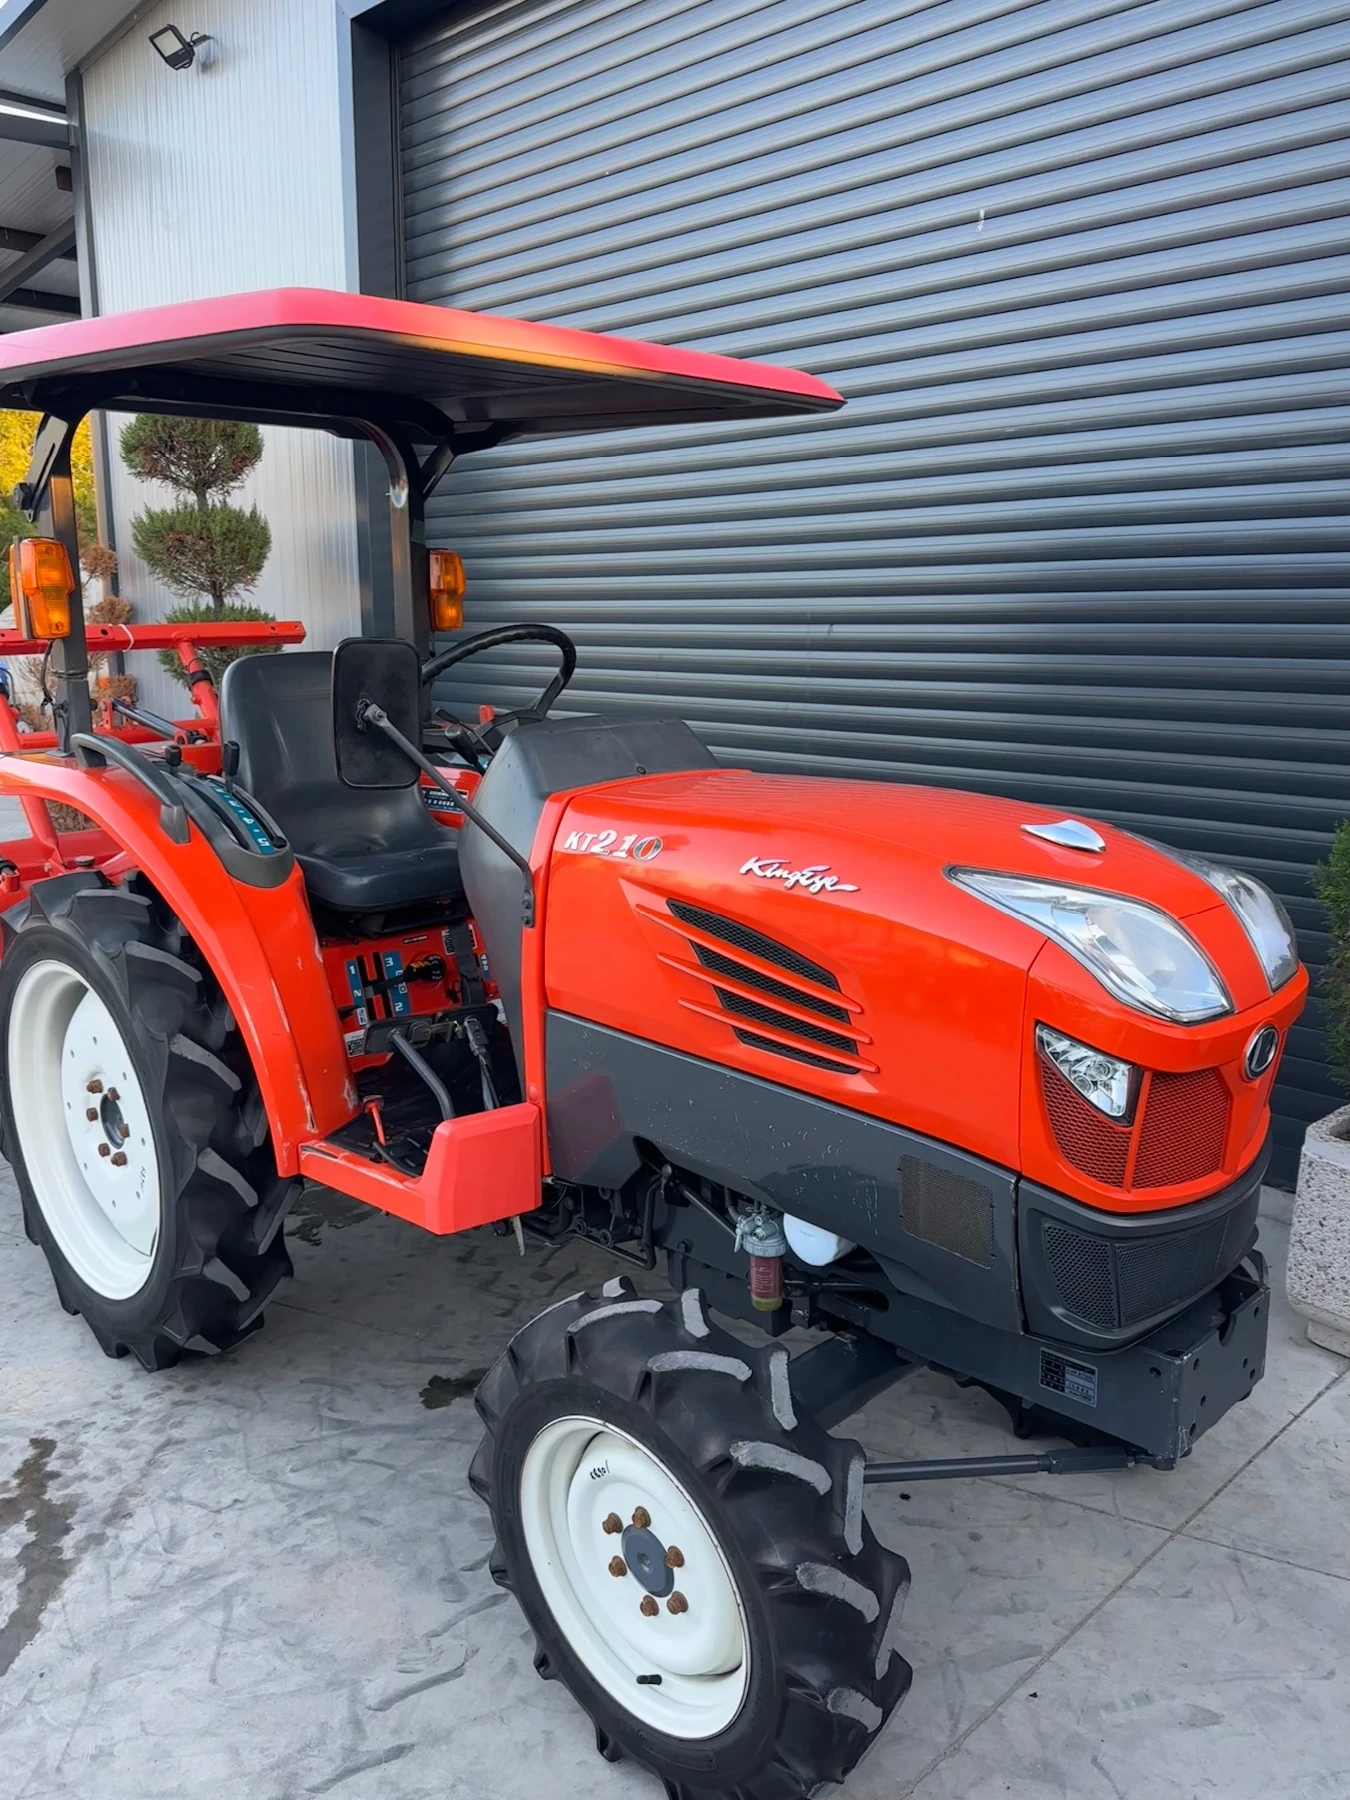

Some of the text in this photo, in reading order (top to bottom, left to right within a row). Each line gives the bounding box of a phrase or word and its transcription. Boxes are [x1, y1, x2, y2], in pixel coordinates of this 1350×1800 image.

[563, 829, 663, 862] KT210
[739, 856, 860, 894] KingEye
[384, 957, 394, 967] 3
[349, 965, 356, 975] 1
[394, 1002, 404, 1012] 2
